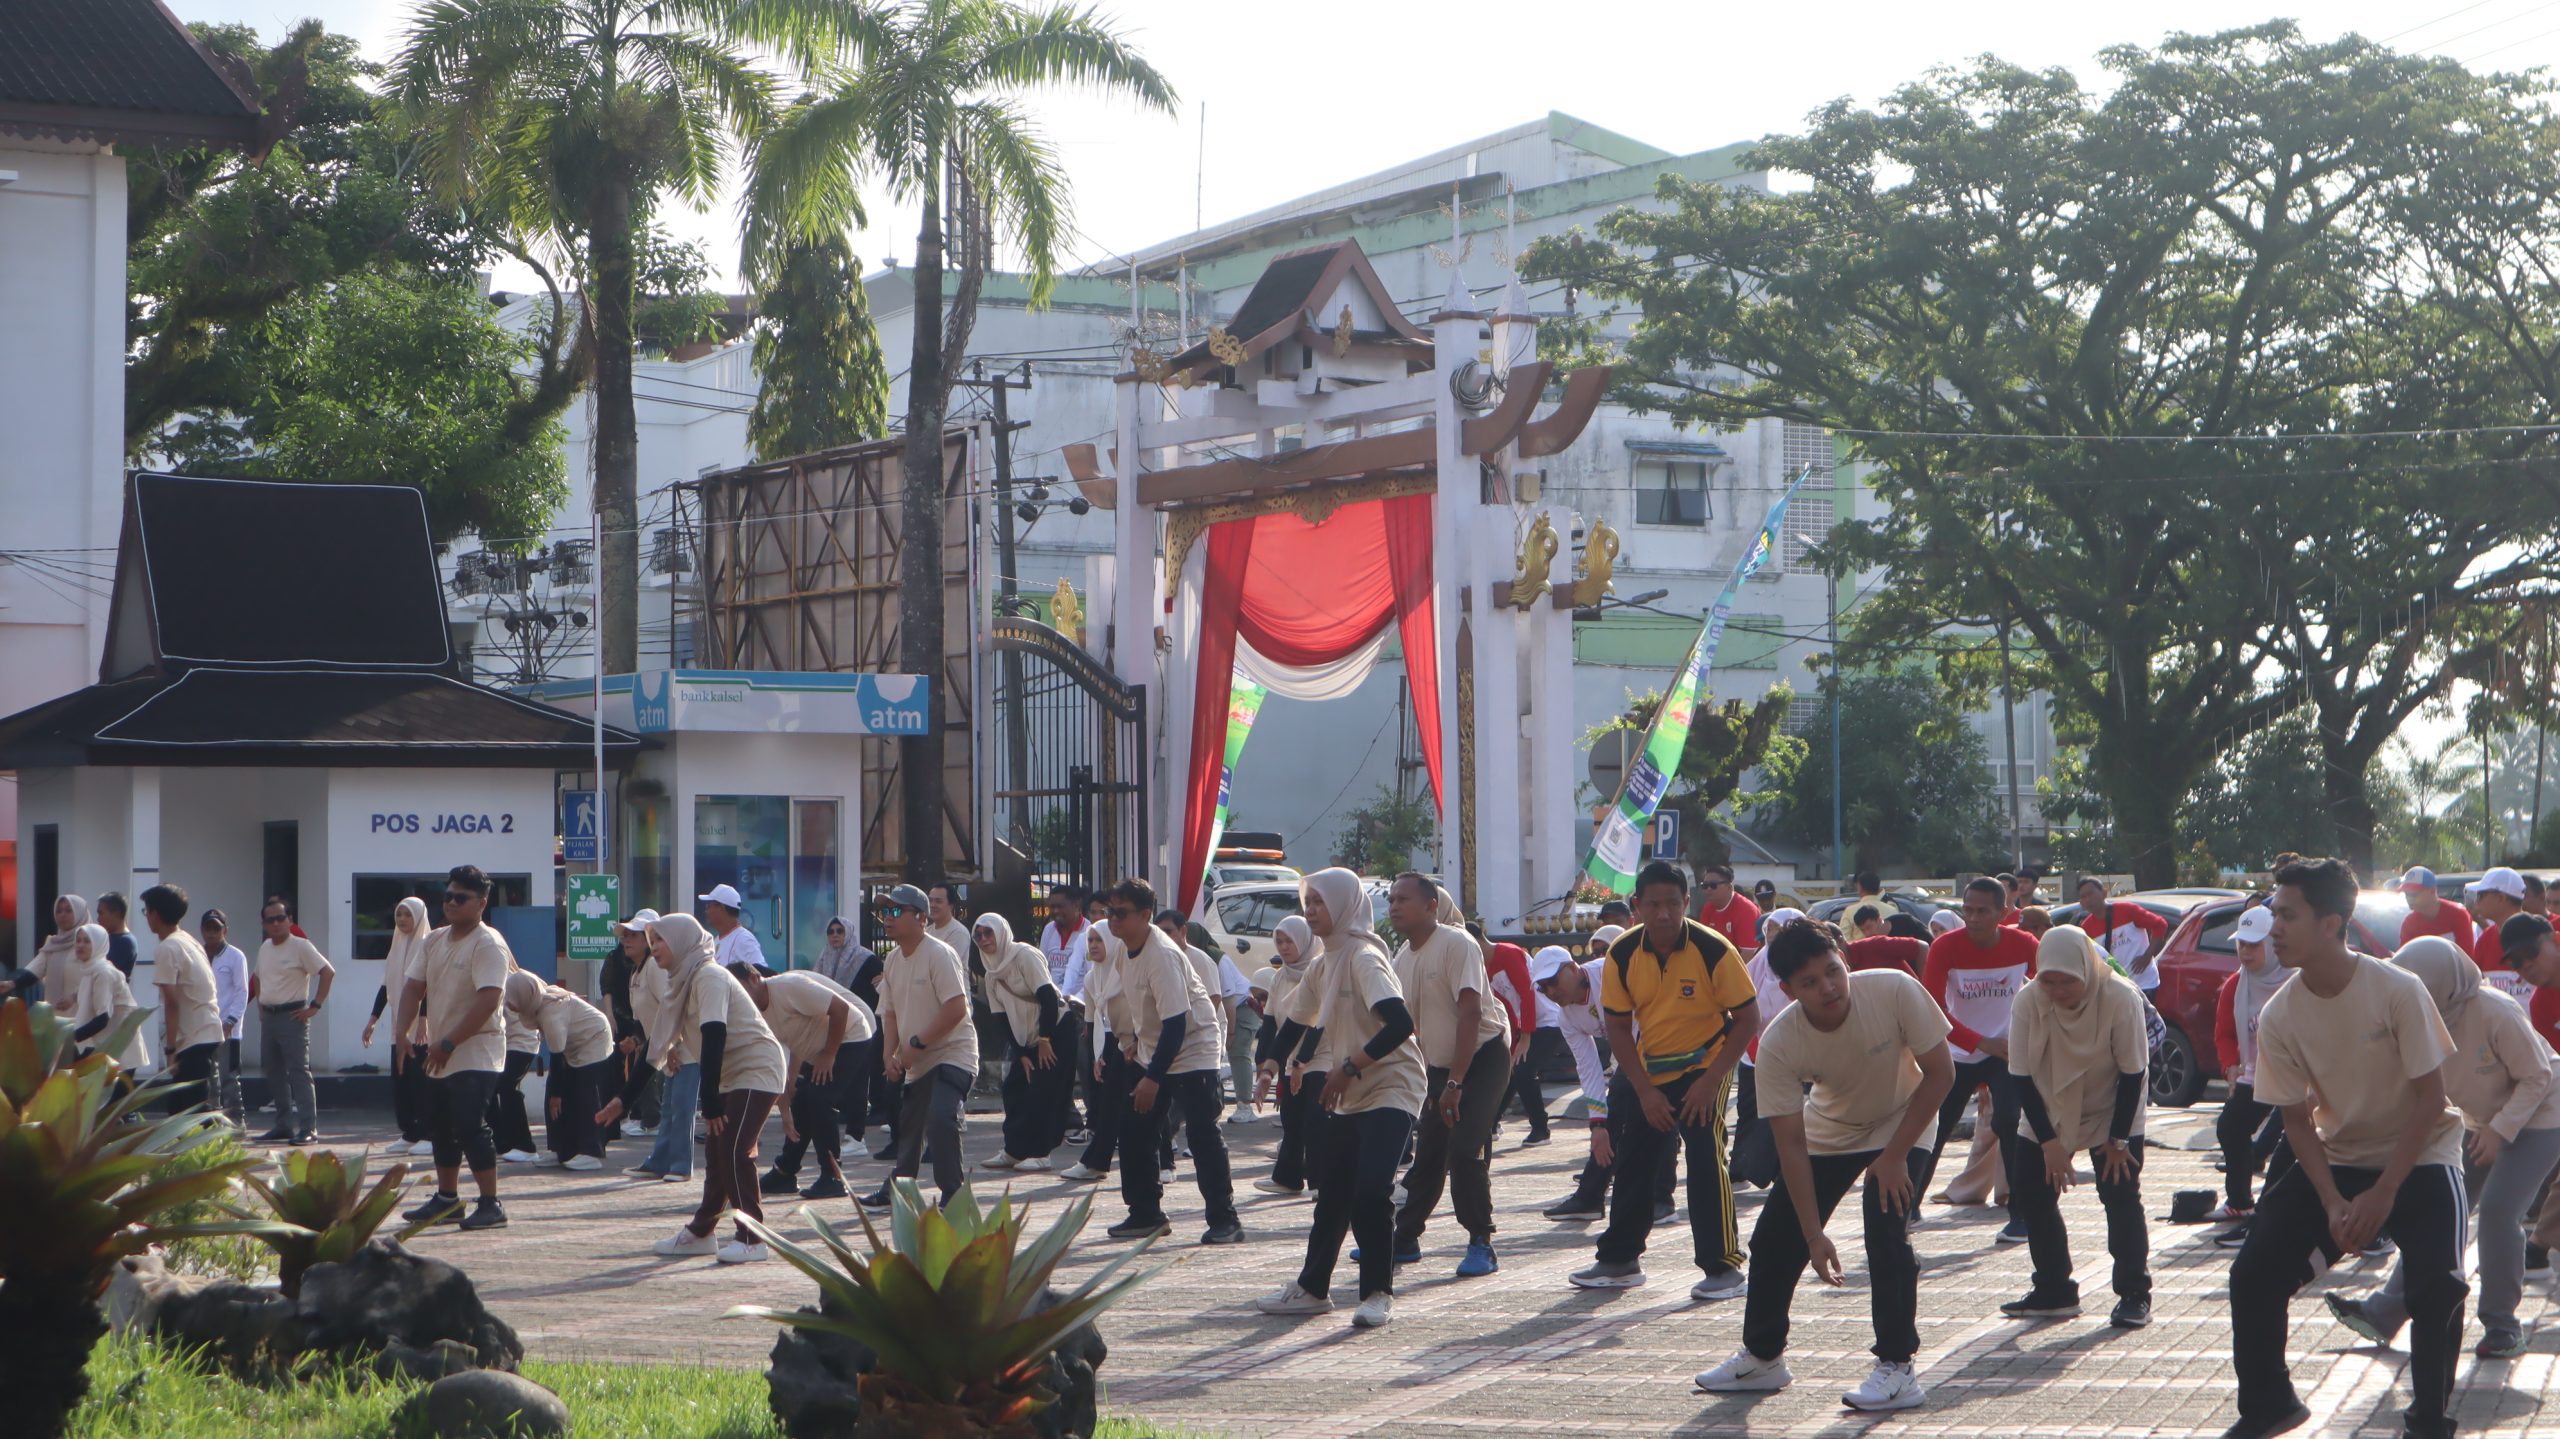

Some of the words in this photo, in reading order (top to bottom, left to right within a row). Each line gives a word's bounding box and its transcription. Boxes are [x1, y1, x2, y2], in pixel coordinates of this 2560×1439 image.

[680, 690, 743, 702] bankkalsel
[640, 704, 665, 727] atm
[870, 706, 922, 729] atm
[371, 813, 420, 833] POS
[431, 813, 493, 833] JAGA
[501, 813, 514, 833] 2
[1657, 814, 1674, 855] P
[571, 936, 589, 945] TITIK
[590, 936, 616, 945] KUMPUL
